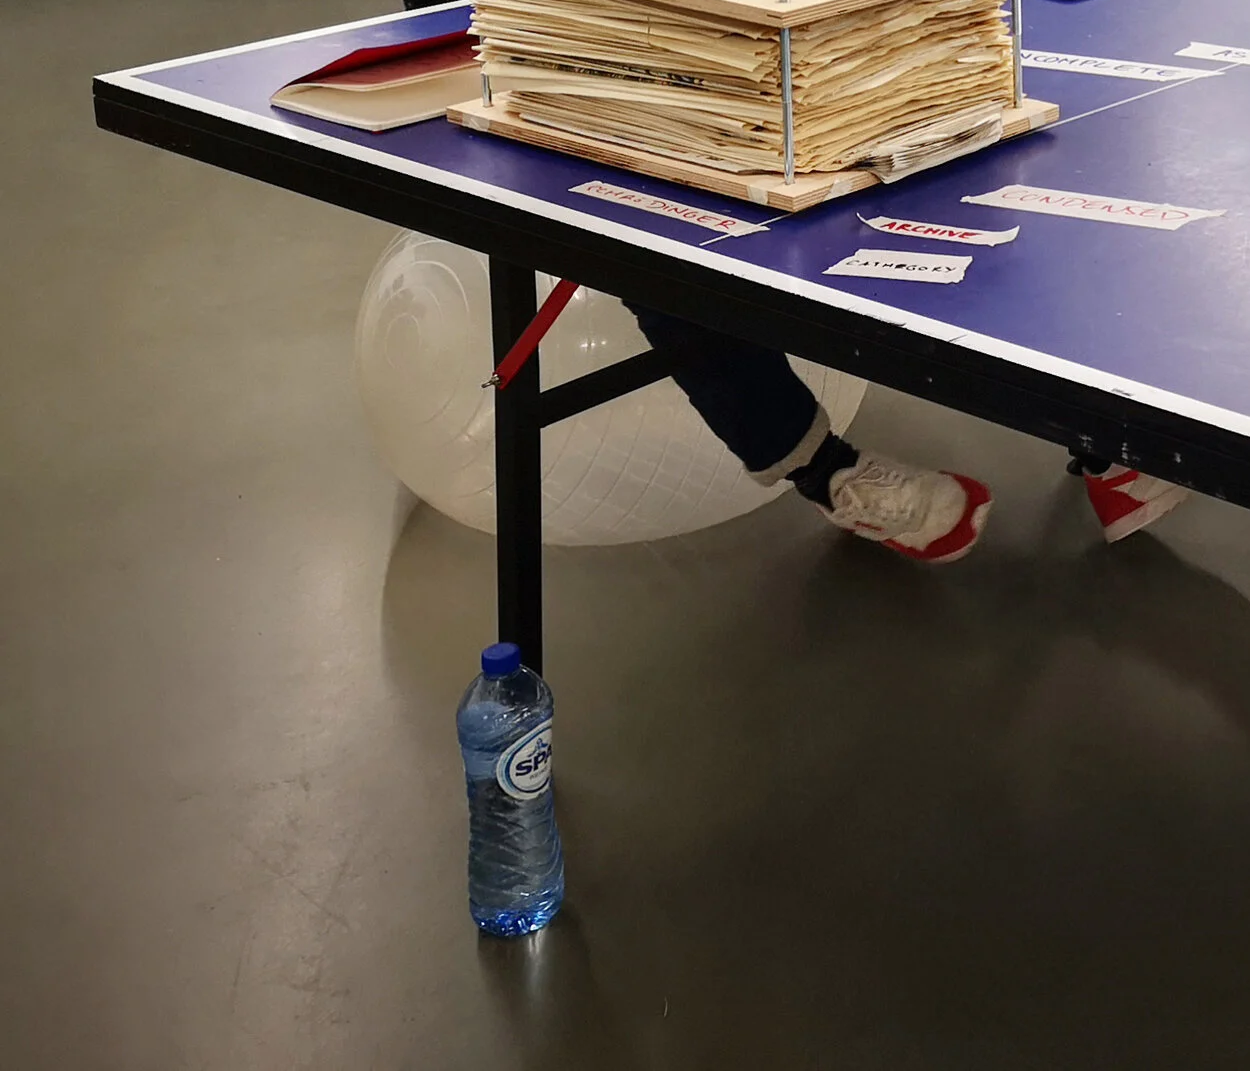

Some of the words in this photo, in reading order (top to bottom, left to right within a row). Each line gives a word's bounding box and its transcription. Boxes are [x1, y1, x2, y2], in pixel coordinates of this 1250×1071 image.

[1211, 49, 1247, 59] AS
[1021, 53, 1180, 77] NCOMPLETE
[879, 220, 984, 240] ARCHIVE
